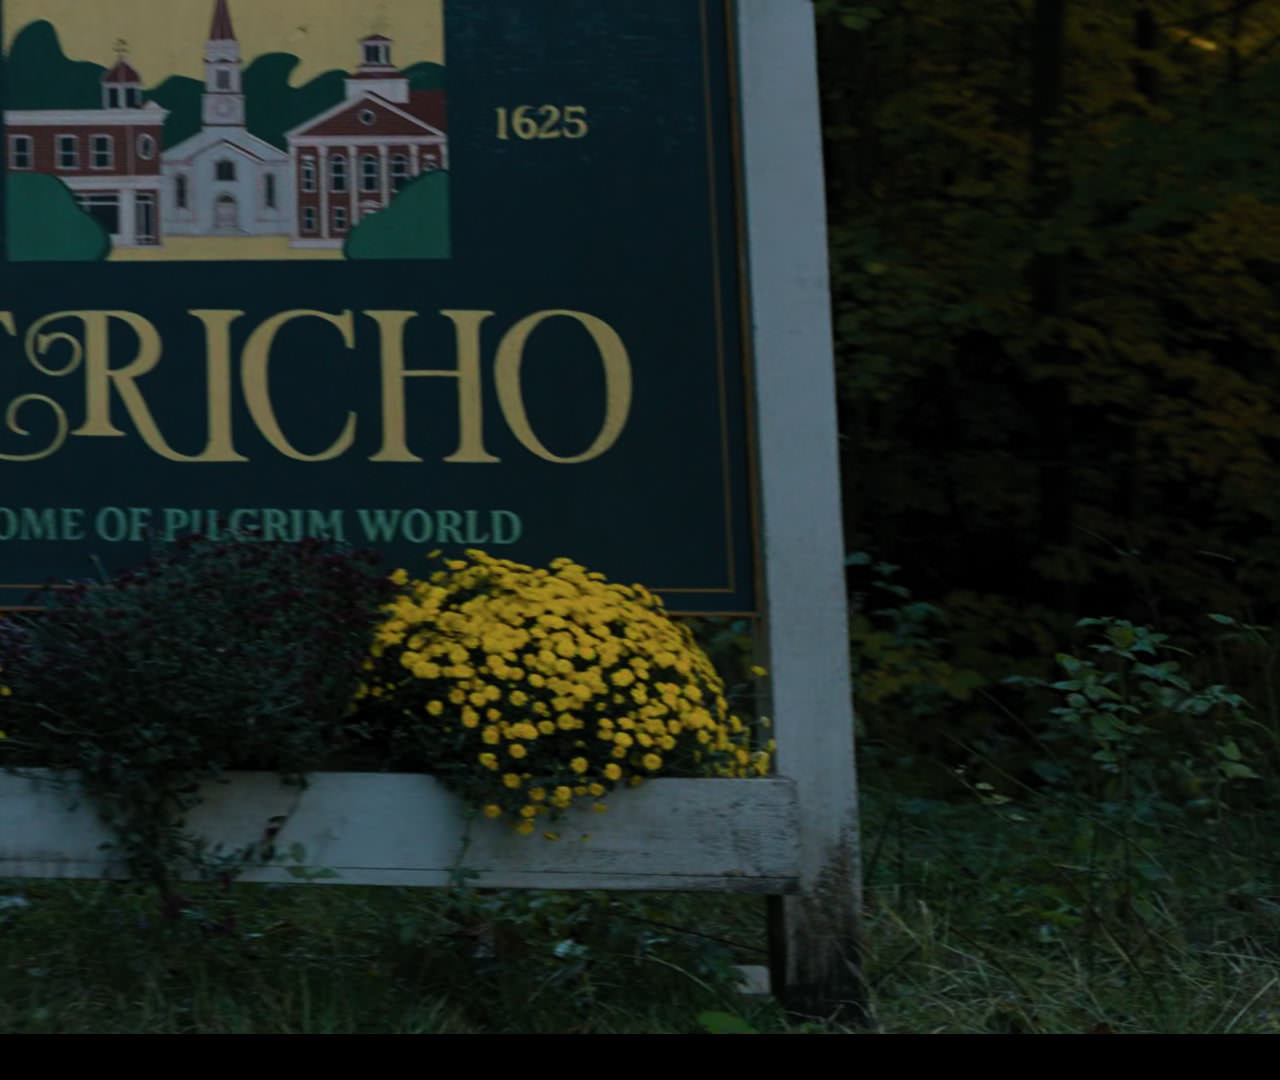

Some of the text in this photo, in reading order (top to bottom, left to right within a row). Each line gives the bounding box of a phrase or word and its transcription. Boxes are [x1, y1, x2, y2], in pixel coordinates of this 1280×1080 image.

[494, 105, 588, 140] 1625
[96, 506, 152, 541] OF
[161, 507, 343, 543] PILGRIM
[357, 508, 522, 544] WORLD
